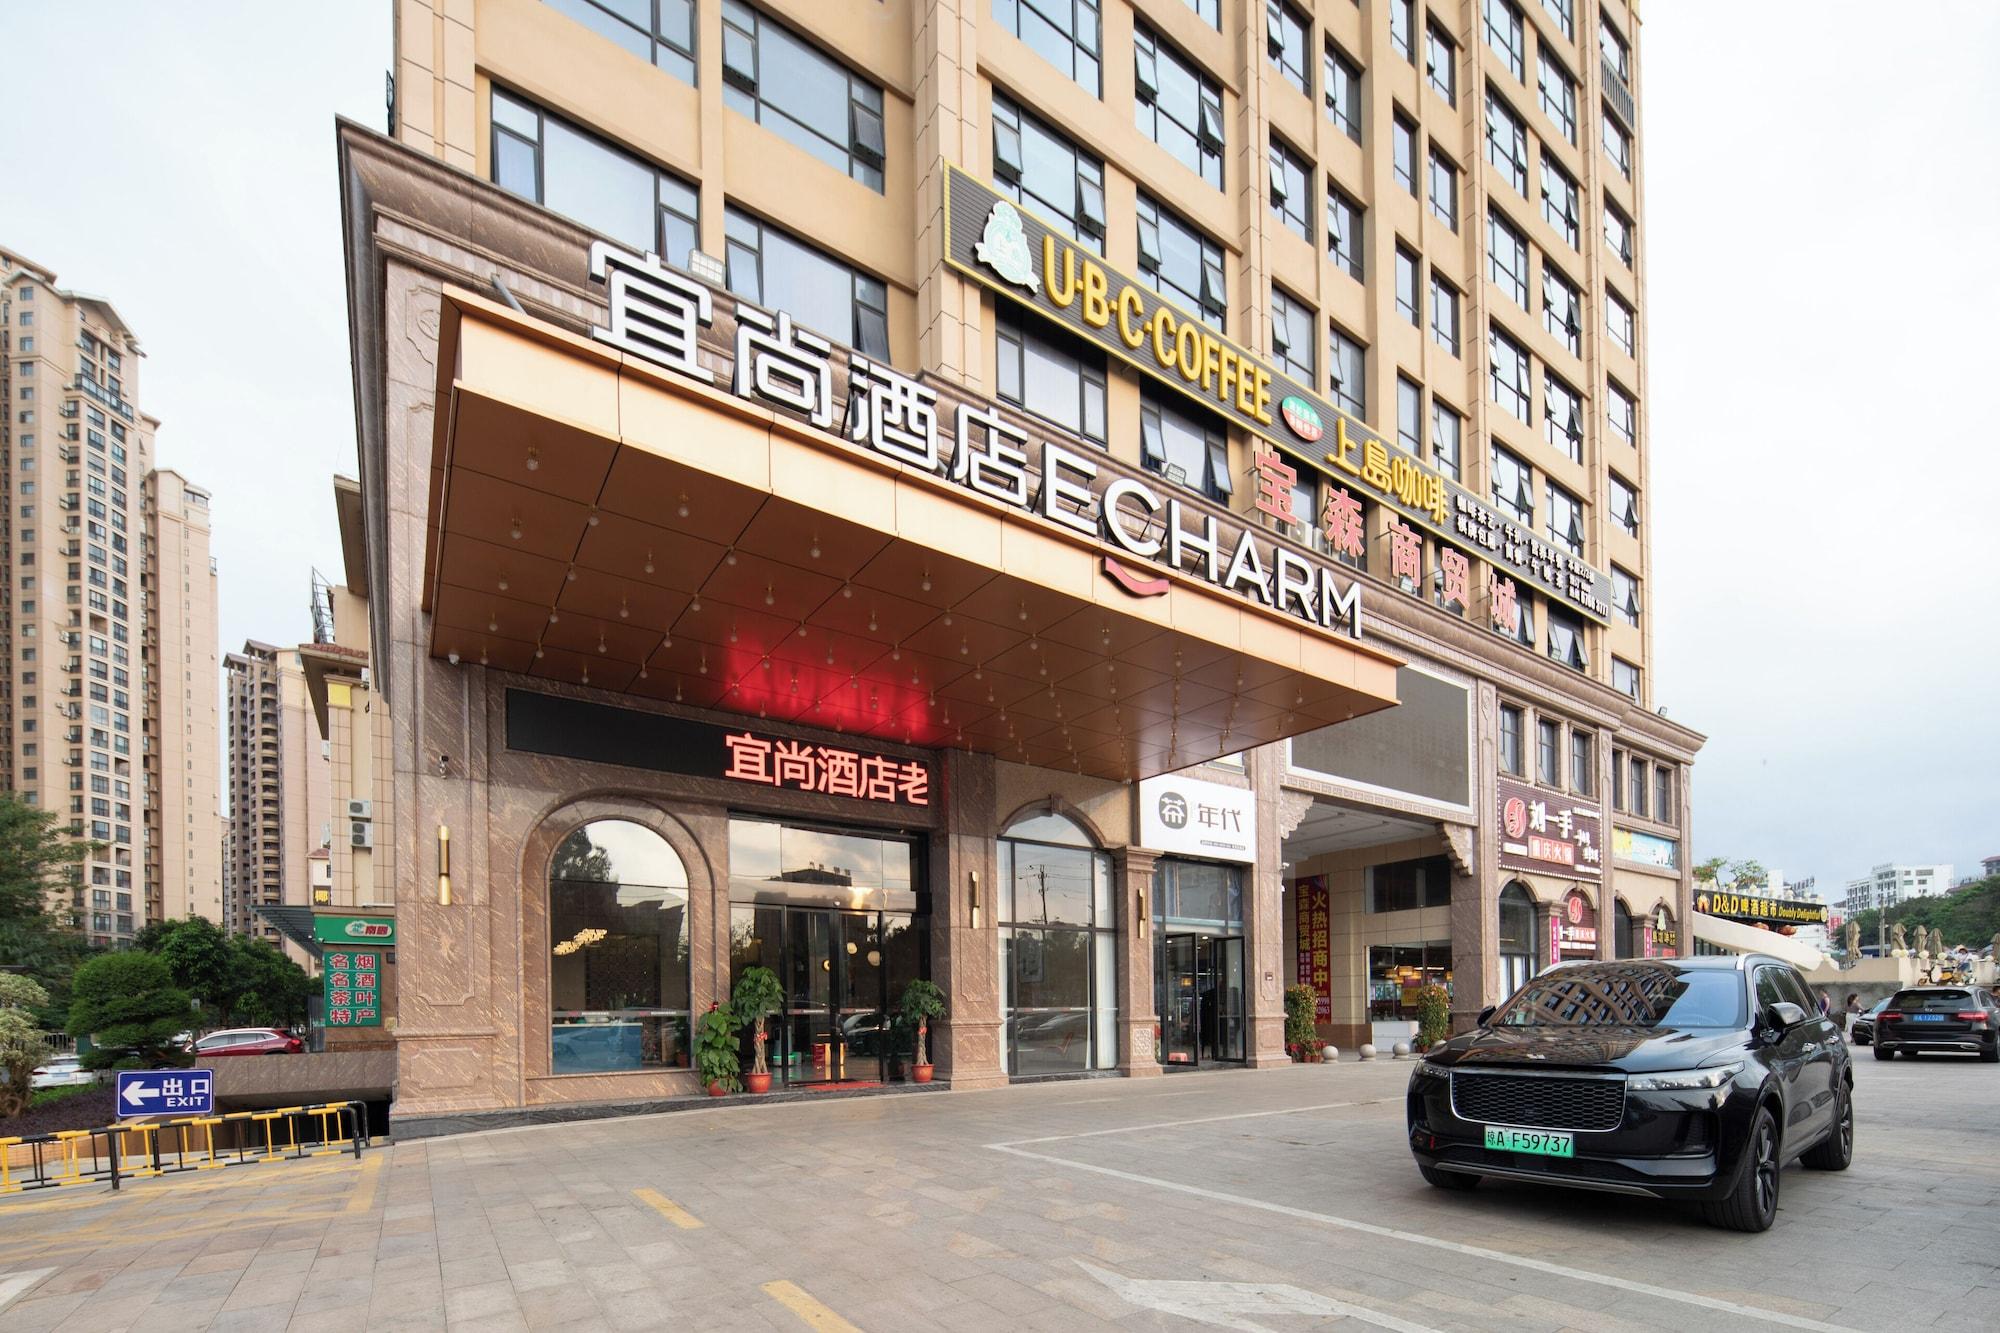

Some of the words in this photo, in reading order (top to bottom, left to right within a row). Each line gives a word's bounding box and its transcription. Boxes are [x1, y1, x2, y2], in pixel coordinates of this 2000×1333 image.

[589, 240, 1029, 507] 宜尚酒店
[1041, 443, 1361, 640] ECHARM
[1254, 449, 1517, 634] 宝森商贸城
[725, 732, 929, 806] 宜尚酒店老
[1712, 894, 1739, 915] D&D
[1740, 898, 1777, 918] 啤酒超市
[1312, 890, 1328, 988] 火热招商中
[330, 953, 375, 970] 名烟
[330, 972, 376, 989] 名酒
[330, 990, 376, 1007] 茶叶
[330, 1009, 376, 1025] 特产
[162, 1078, 209, 1097] 出口
[166, 1096, 205, 1108] EXIT
